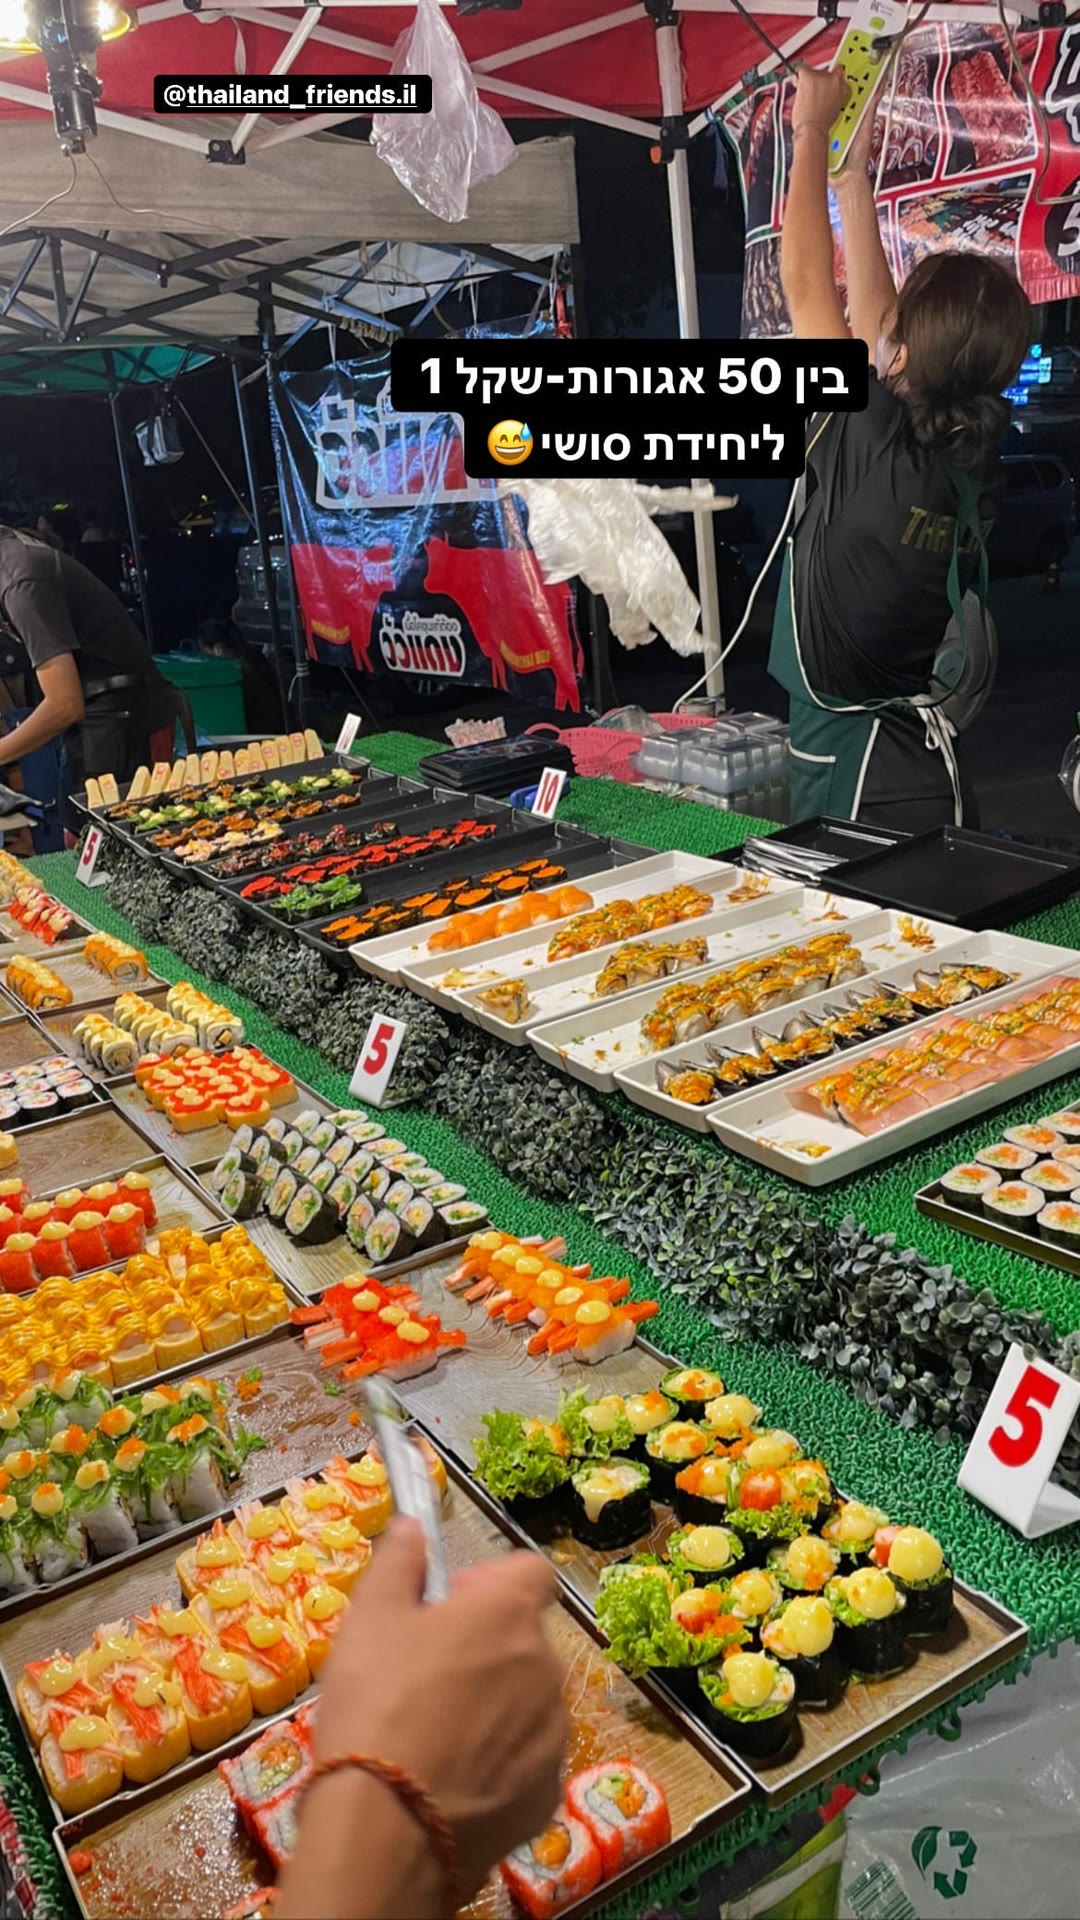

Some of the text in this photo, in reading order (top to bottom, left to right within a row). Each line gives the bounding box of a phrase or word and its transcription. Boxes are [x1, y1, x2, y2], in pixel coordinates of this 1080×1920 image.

[537, 774, 560, 813] 10
[82, 832, 99, 867] 5
[362, 1023, 396, 1076] 5
[987, 1365, 1062, 1469] 5
